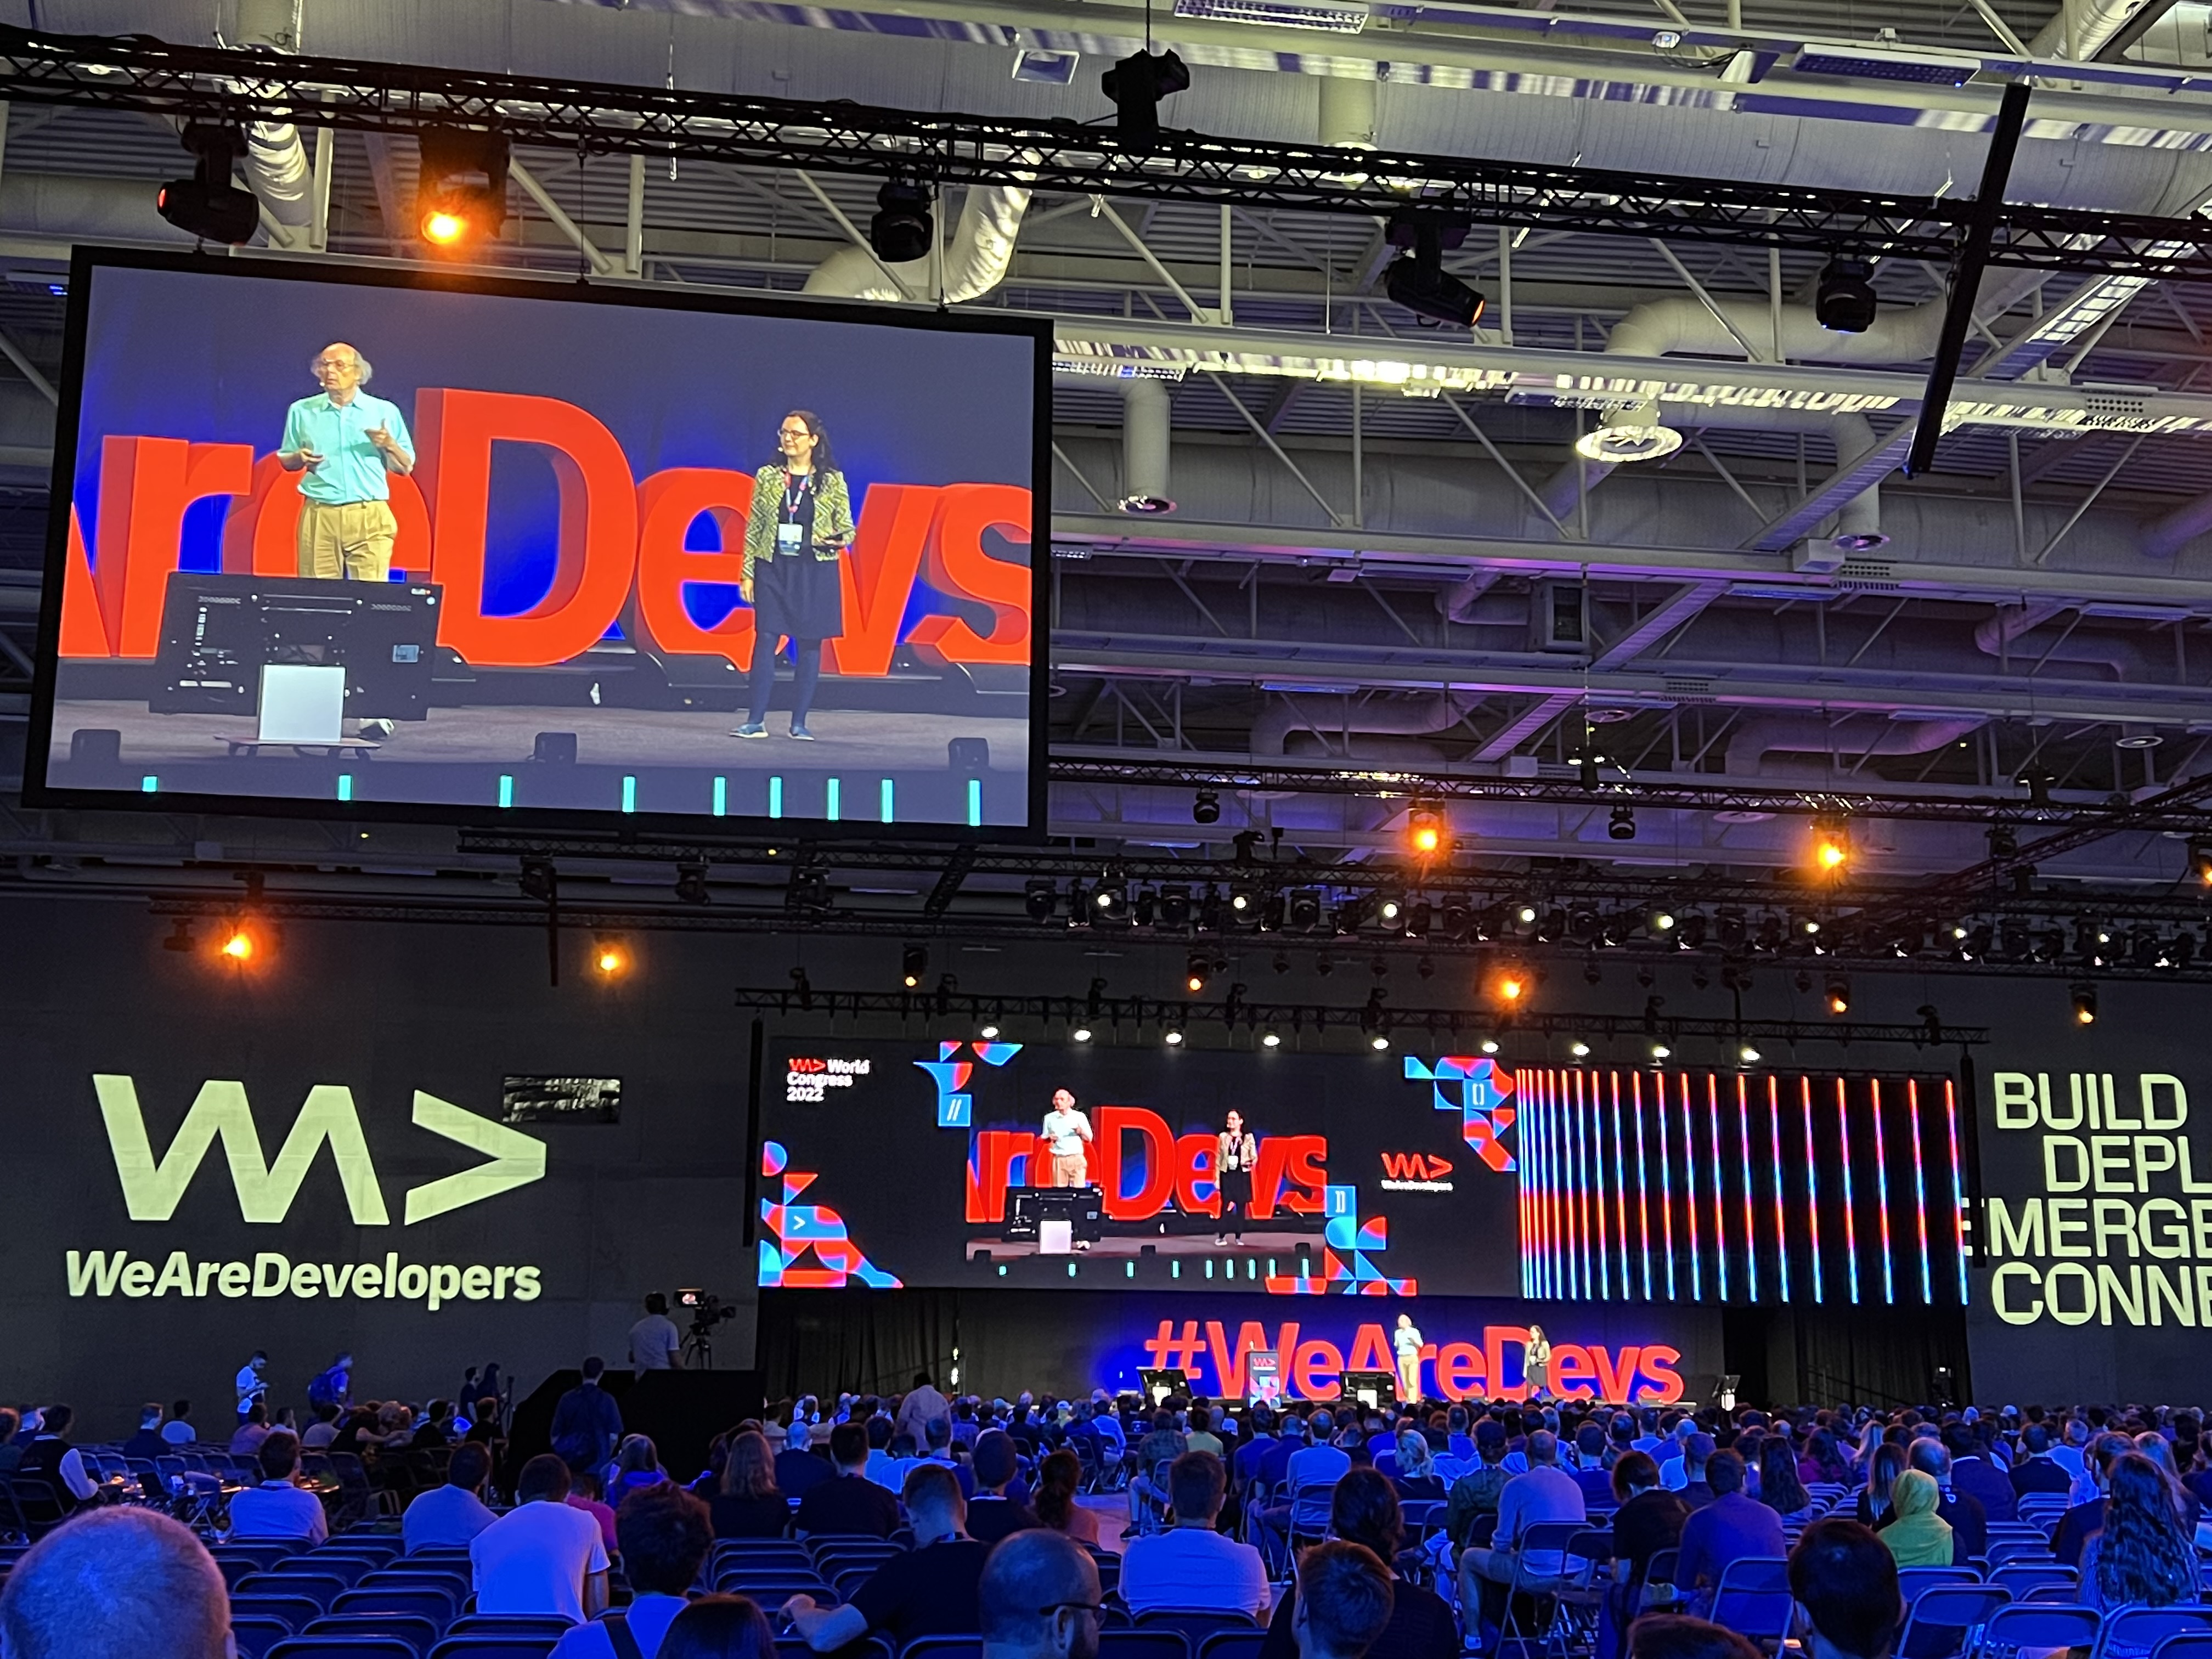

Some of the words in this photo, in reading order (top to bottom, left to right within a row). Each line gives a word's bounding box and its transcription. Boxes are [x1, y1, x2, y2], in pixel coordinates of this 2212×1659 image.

[787, 1071, 853, 1088] Congress
[827, 1059, 870, 1074] World
[787, 1086, 824, 1102] 2022
[1994, 1072, 2188, 1130] BUILD
[2043, 1135, 2212, 1193] DEPL
[66, 1250, 541, 1311] WeAreDevelopers
